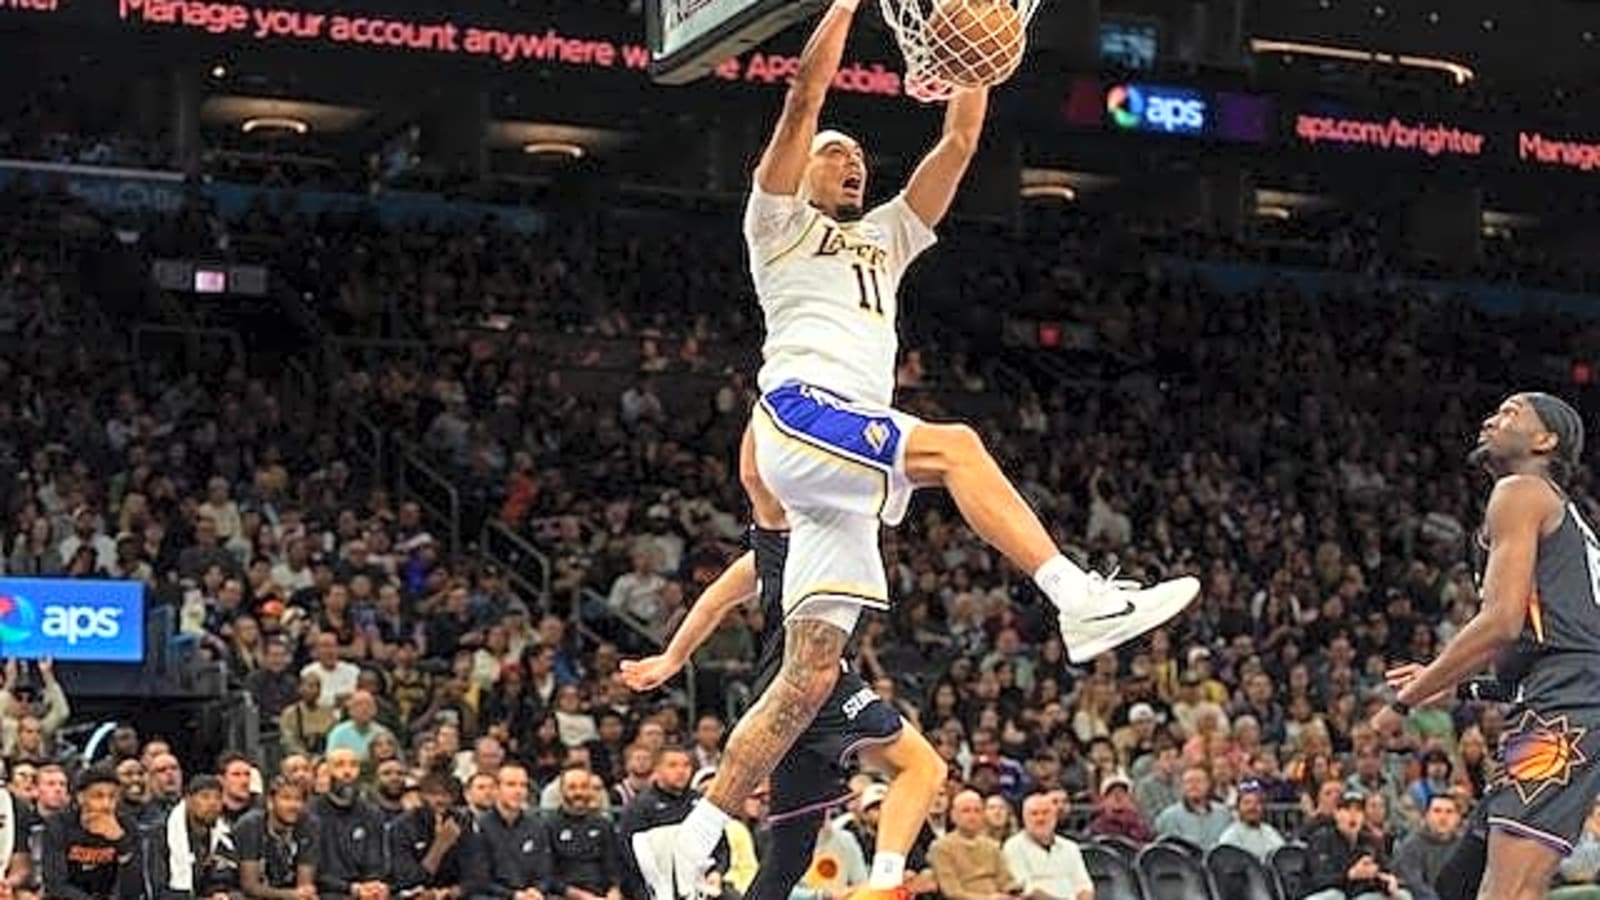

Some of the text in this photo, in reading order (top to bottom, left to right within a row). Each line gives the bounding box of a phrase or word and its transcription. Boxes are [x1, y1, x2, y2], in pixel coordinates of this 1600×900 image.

[119, 0, 248, 33] Manage
[253, 10, 325, 38] your
[330, 16, 457, 50] account
[463, 28, 614, 66] anywhere
[835, 63, 900, 95] obile
[1146, 96, 1204, 131] aps
[1296, 115, 1484, 155] aps.com/brighter
[852, 263, 884, 316] 11
[41, 605, 123, 645] aps
